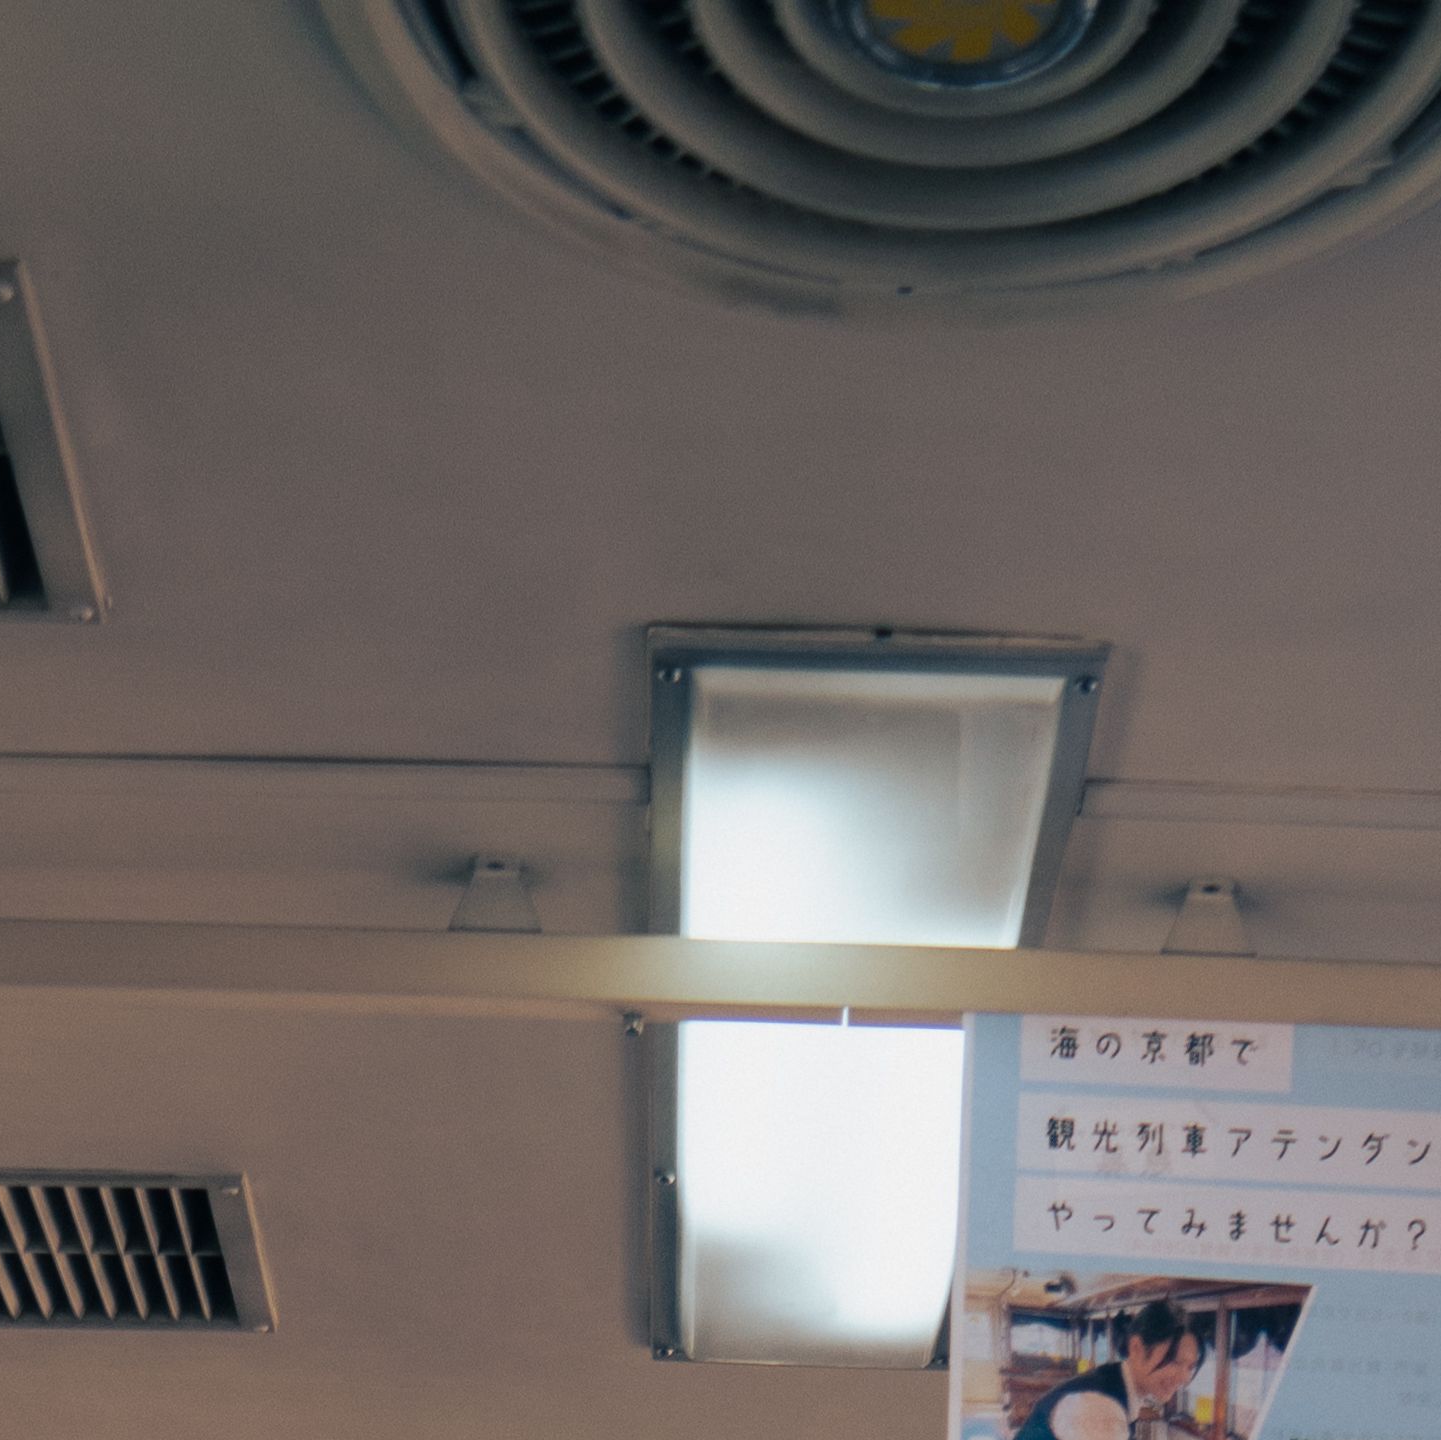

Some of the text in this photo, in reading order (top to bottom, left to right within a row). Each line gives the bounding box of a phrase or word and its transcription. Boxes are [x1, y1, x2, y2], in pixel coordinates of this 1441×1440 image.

[1050, 1027, 1257, 1065] 海の京都で
